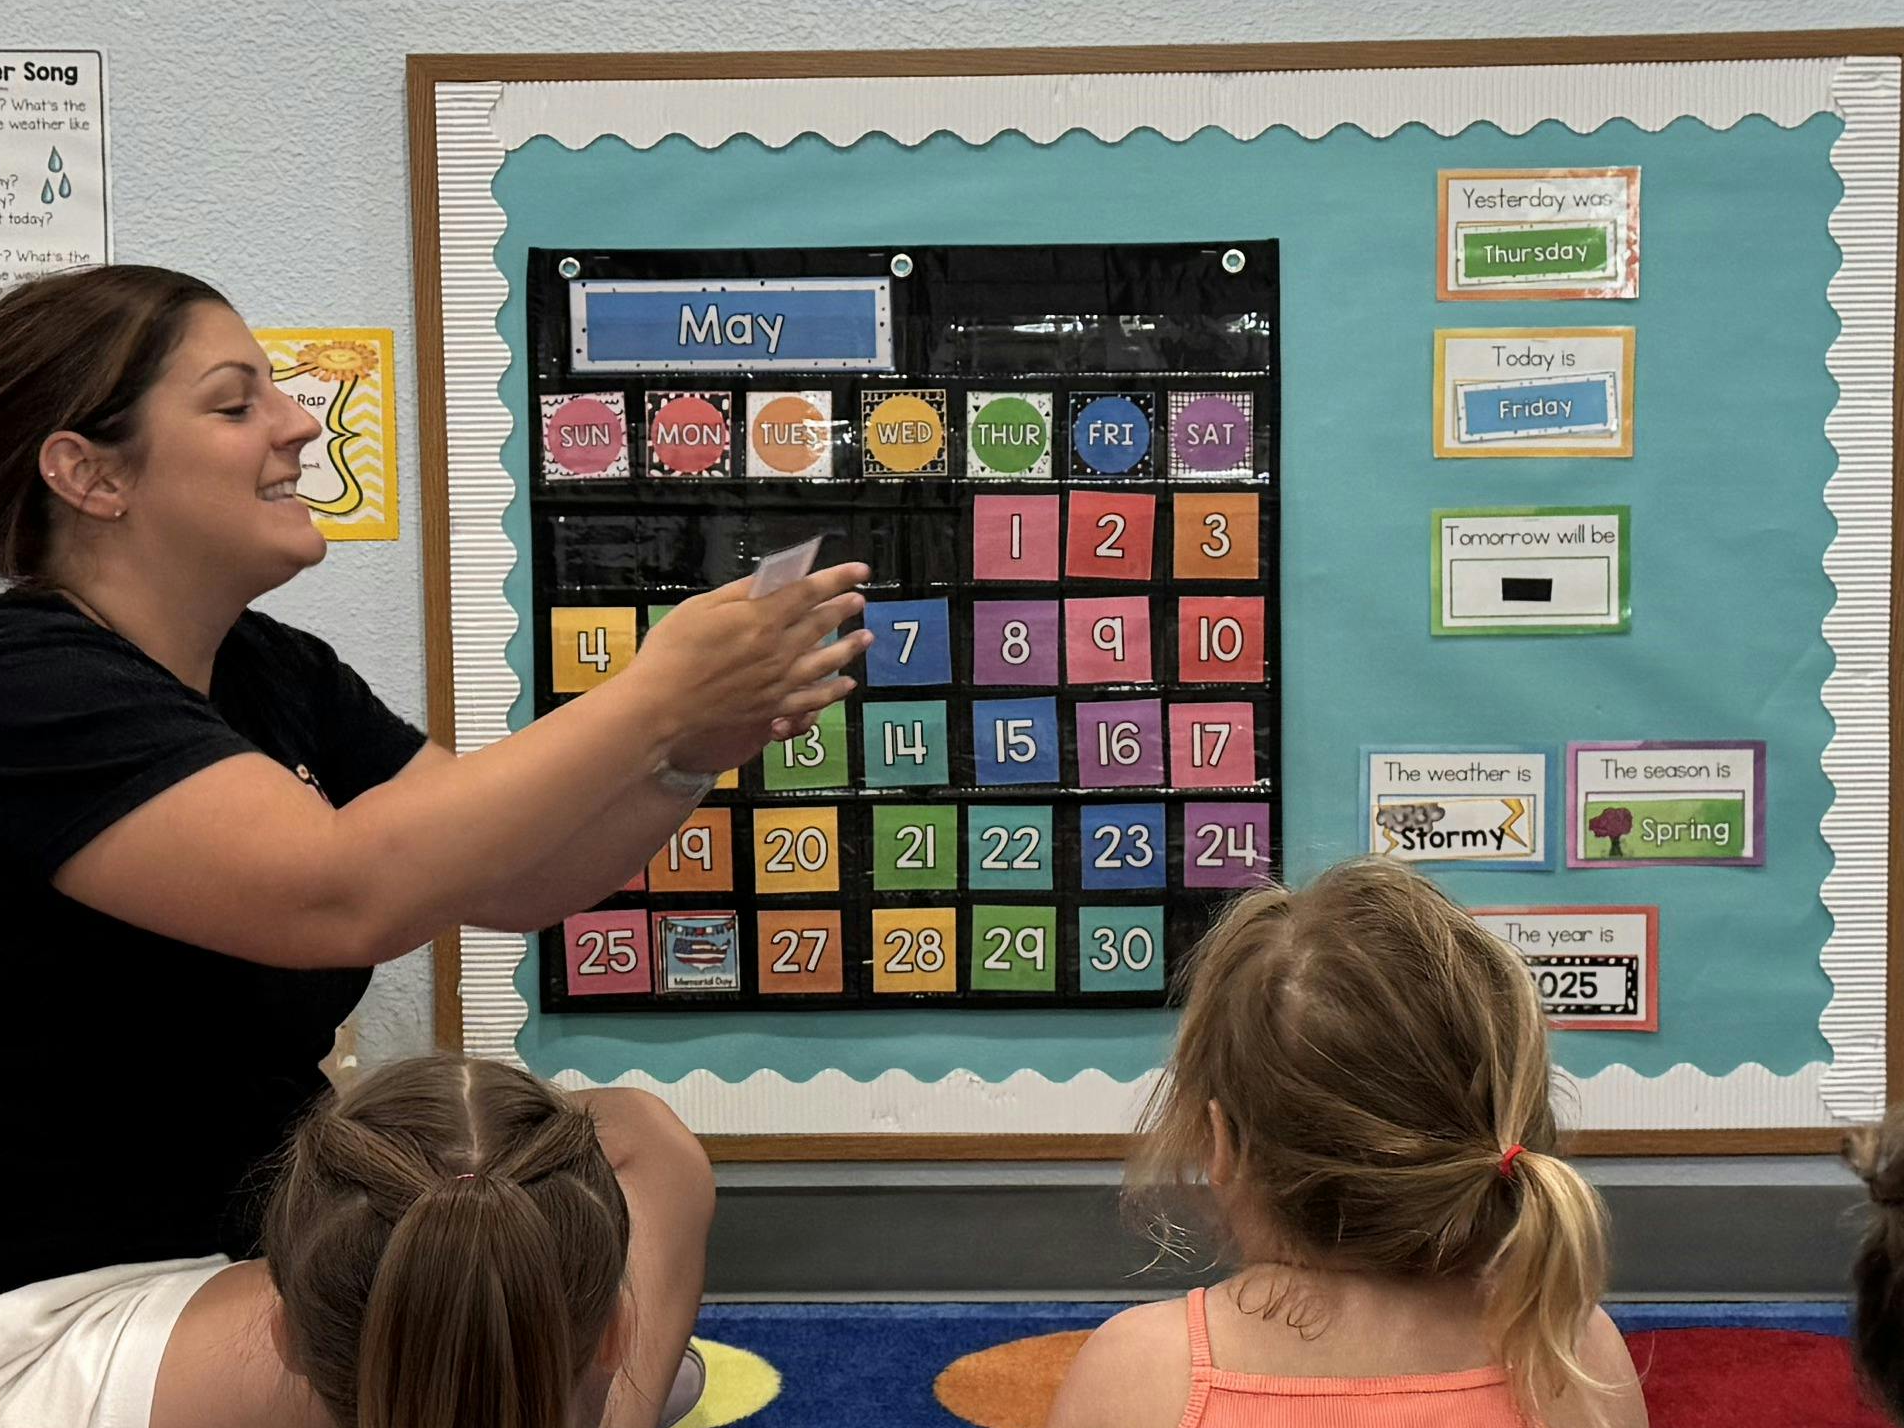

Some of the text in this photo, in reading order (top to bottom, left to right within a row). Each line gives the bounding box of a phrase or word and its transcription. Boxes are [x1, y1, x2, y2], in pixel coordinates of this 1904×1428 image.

[24, 62, 77, 85] Song
[12, 99, 58, 111] What's
[64, 100, 86, 112] the
[9, 118, 64, 130] weather
[69, 118, 89, 131] like
[1462, 187, 1612, 214] Yesterday was
[9, 211, 53, 227] today?
[1483, 240, 1589, 266] Thursday
[678, 305, 785, 354] May
[1492, 345, 1576, 371] Today is
[297, 394, 326, 408] Rap
[1499, 395, 1573, 420] Friday
[559, 422, 1234, 448] SUN MON TUES WED THUR FRI SAT
[1009, 513, 1232, 558] 1 2 3
[1445, 525, 1616, 547] Tomorrow will be
[577, 617, 1245, 671] 4 7 8 9 10
[784, 719, 1231, 768] 13 14 15 16 17
[1384, 761, 1532, 783] The weather is
[1600, 759, 1731, 780] The season is
[1401, 824, 1505, 850] Stormy
[1641, 817, 1730, 846] Spring
[669, 824, 1257, 872] 19 20 21 22 23 24
[1505, 923, 1614, 947] The year is
[576, 926, 1154, 973] 25 27 28 29 30
[1532, 971, 1597, 999] 025
